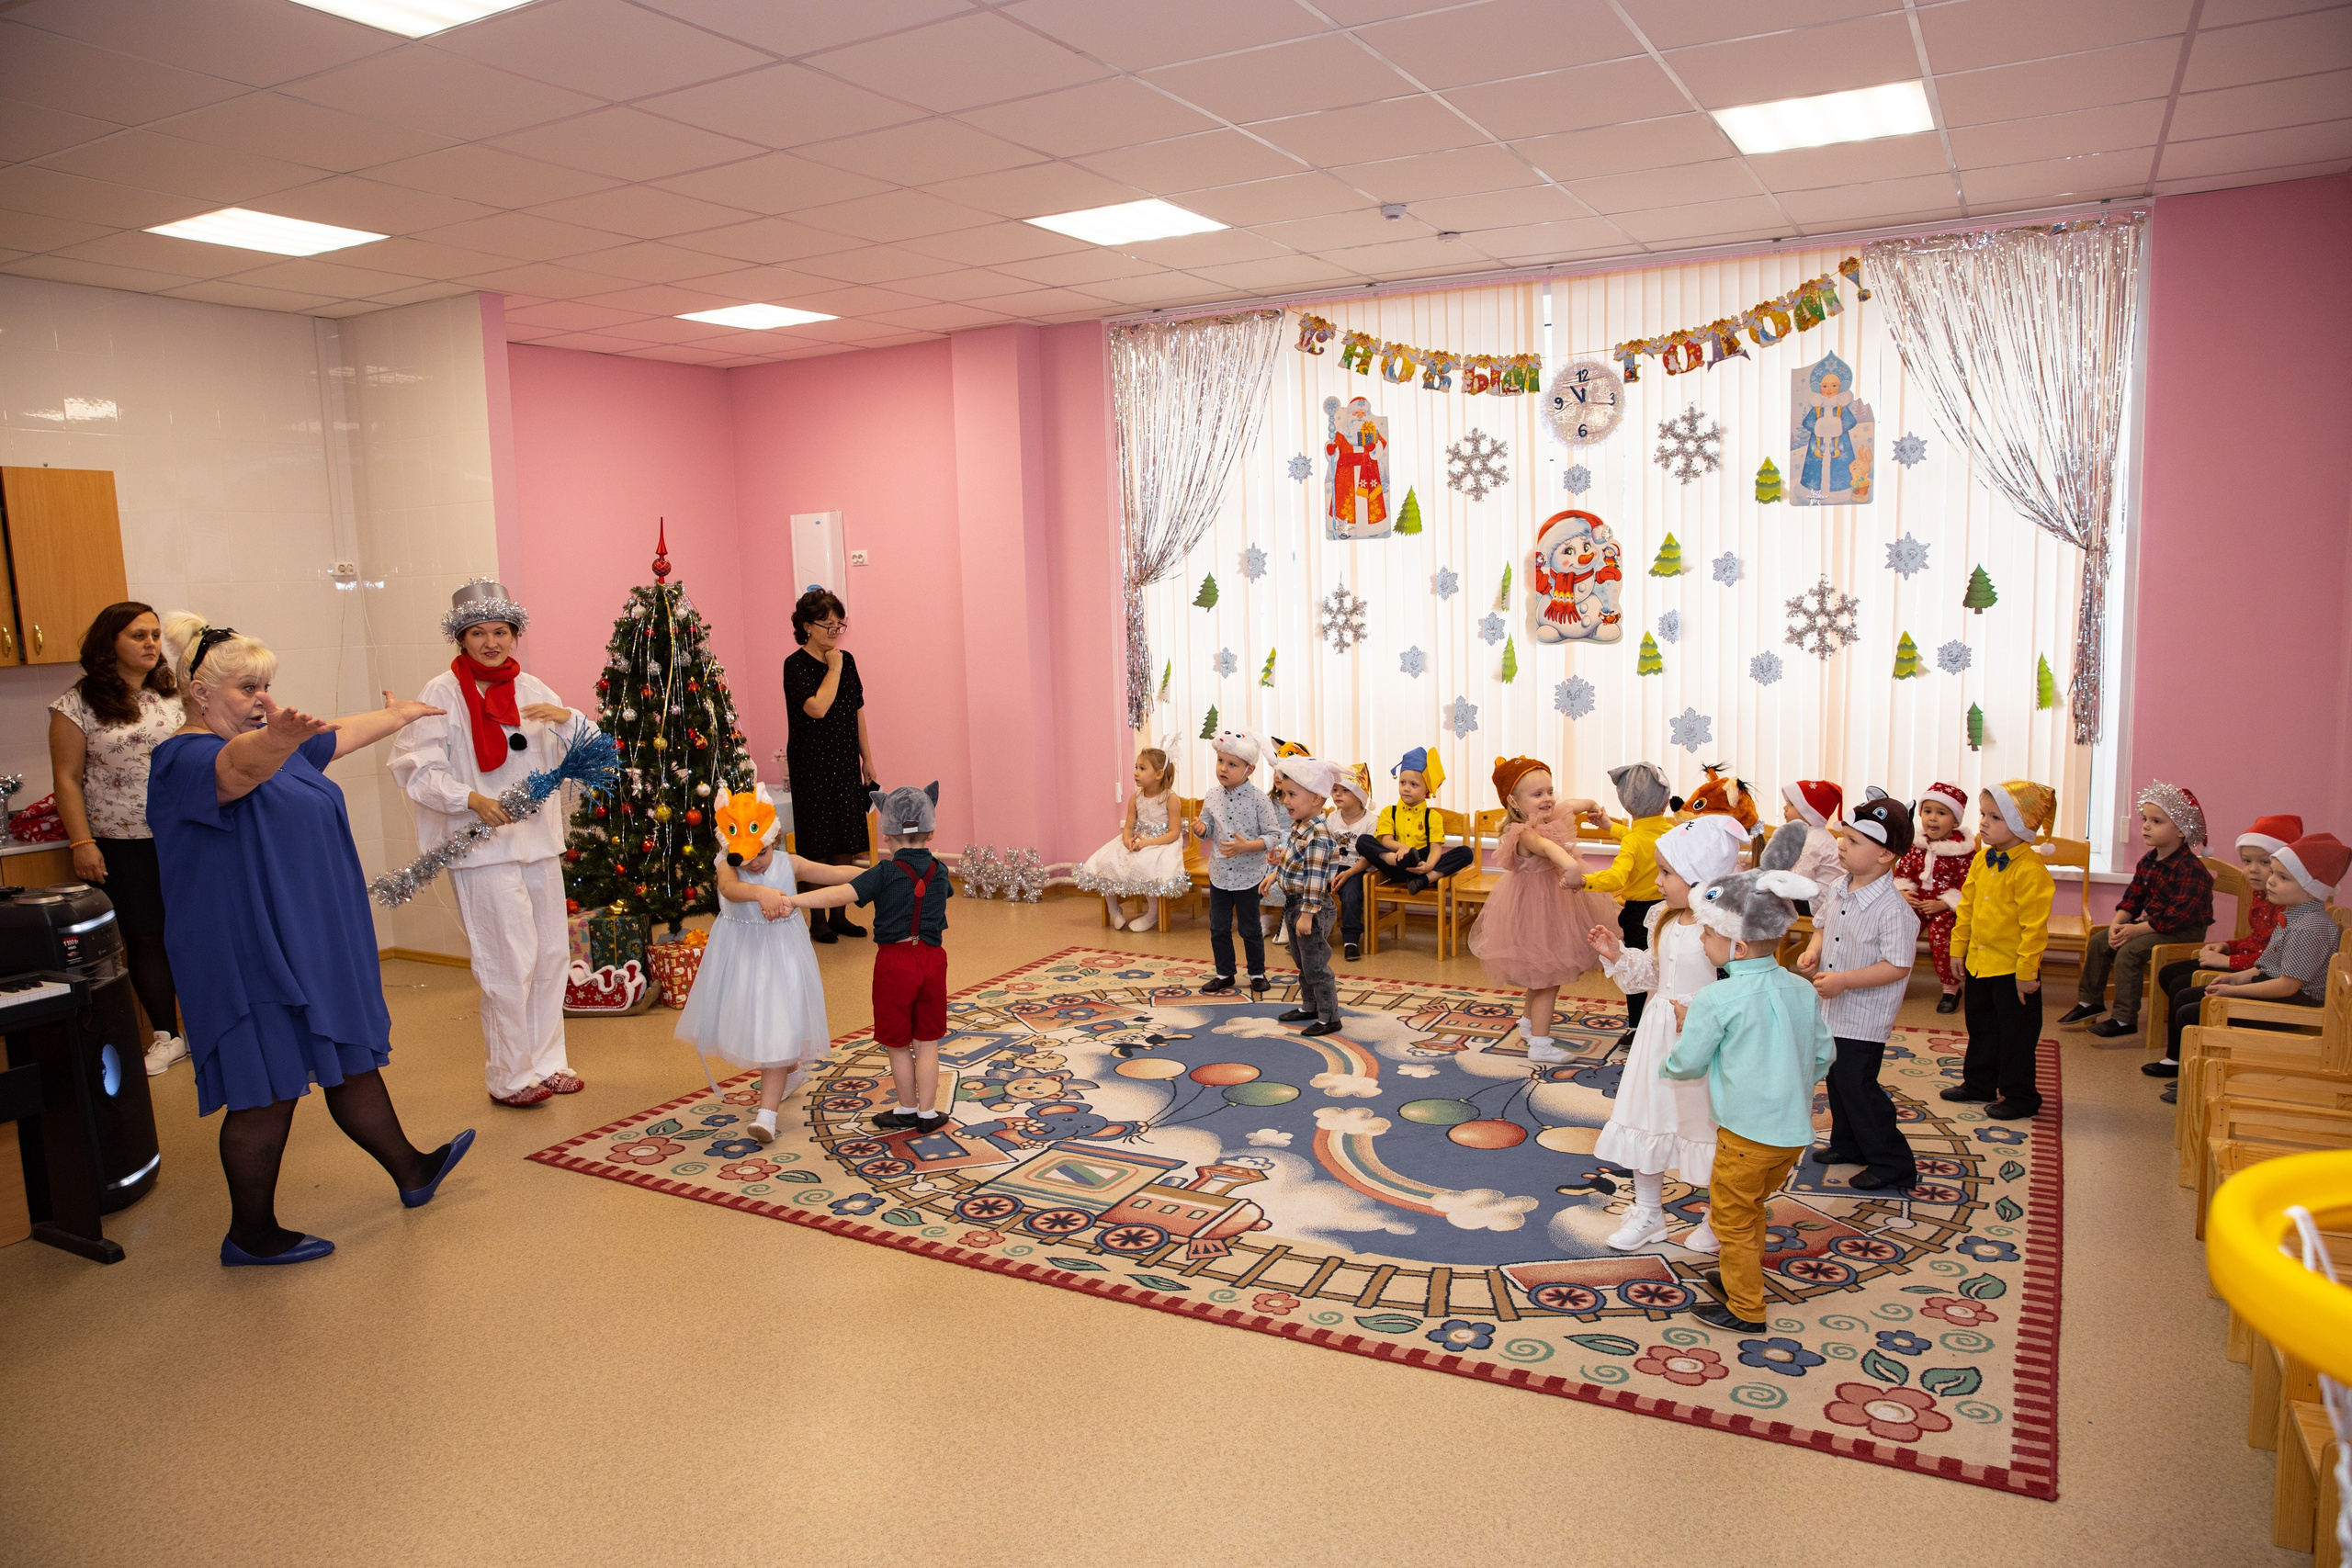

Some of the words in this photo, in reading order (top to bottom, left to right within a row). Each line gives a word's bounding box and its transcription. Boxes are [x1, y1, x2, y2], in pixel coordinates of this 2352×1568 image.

[1338, 330, 1543, 397] НОВЫМ
[1576, 369, 1589, 382] 12
[1555, 397, 1564, 410] 9
[1608, 392, 1615, 406] 3
[1577, 423, 1588, 437] 6
